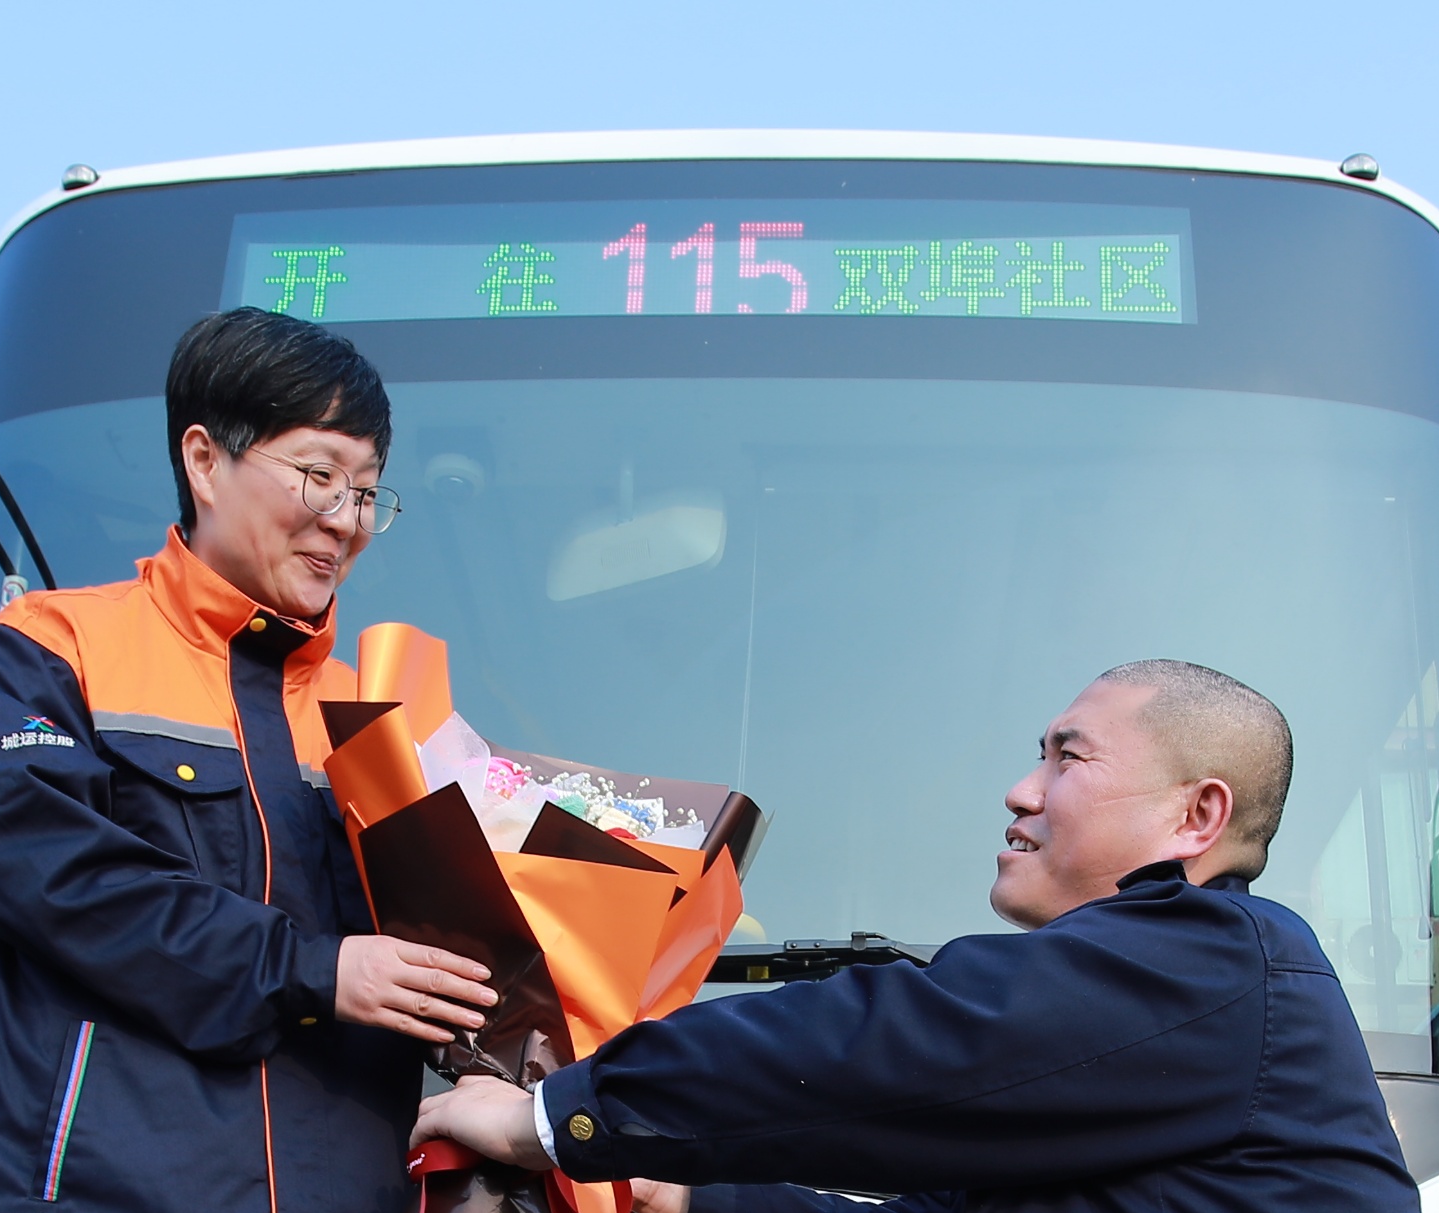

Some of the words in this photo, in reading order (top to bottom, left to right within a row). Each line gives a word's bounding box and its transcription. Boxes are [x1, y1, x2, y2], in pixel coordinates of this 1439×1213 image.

[602, 222, 808, 314] 115
[833, 240, 1177, 315] 双埠社区
[0, 731, 76, 751] 城运控股
